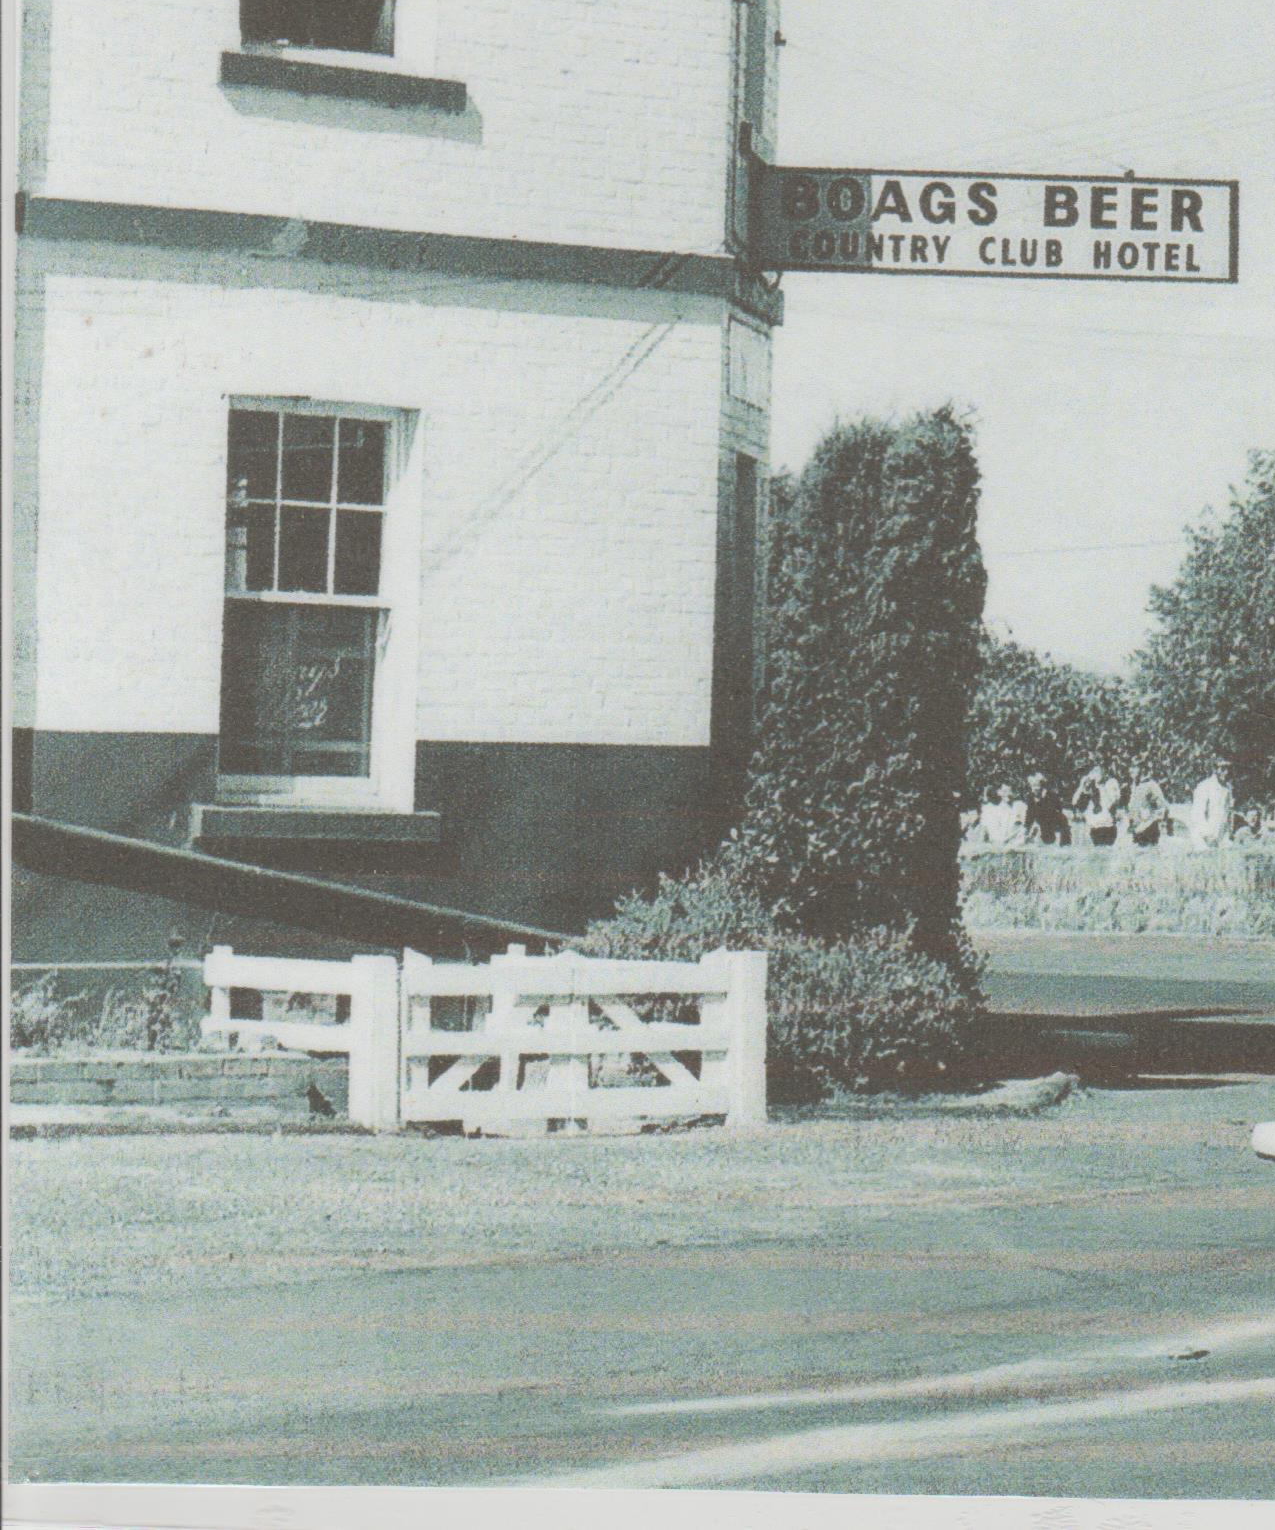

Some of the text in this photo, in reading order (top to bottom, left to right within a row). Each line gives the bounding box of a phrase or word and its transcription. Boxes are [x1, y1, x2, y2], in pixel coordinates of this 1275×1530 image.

[783, 177, 1204, 233] BOAGS BEER
[788, 228, 1202, 272] COUNTRY CLUB HOTEL
